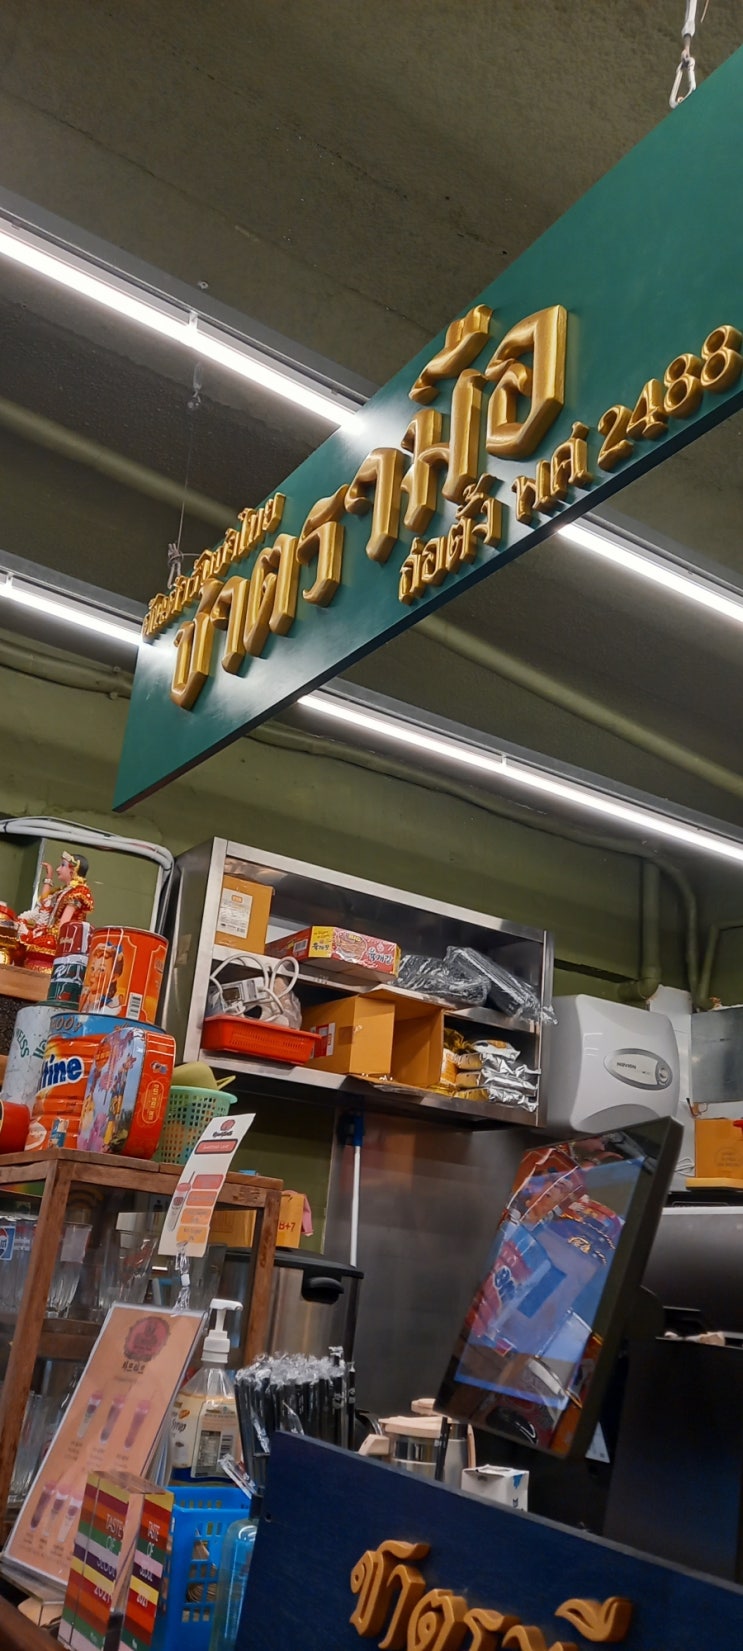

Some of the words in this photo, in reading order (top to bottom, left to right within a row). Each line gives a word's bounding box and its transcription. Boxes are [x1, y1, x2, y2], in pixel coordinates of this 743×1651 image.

[398, 473, 503, 606] ก่อตั้ง
[597, 325, 743, 472] 2488
[105, 1513, 123, 1538] TASTE
[105, 1535, 116, 1552] OF
[146, 1541, 155, 1557] OF
